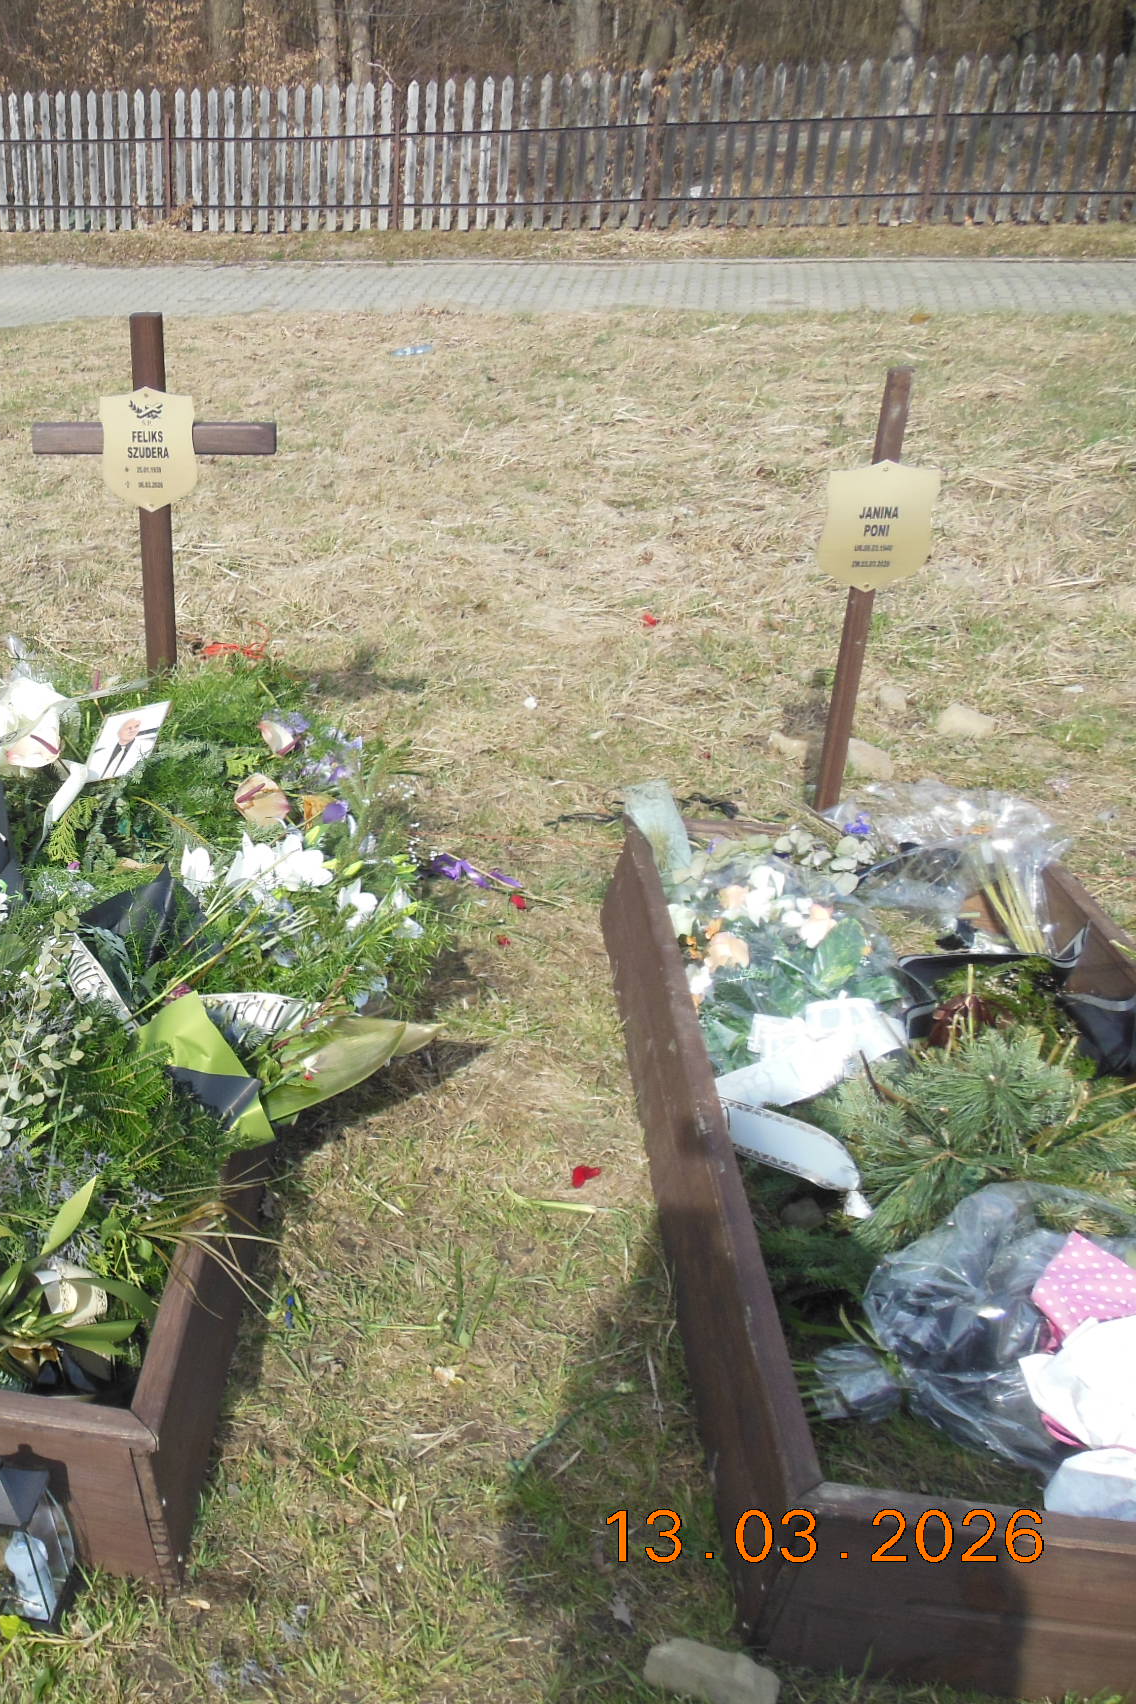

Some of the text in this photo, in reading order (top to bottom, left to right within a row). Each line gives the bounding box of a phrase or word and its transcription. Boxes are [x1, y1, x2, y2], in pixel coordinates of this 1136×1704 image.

[131, 430, 164, 443] FELIKS
[127, 446, 170, 459] SZUDERA
[859, 506, 899, 519] JANINA
[863, 524, 890, 537] PONI
